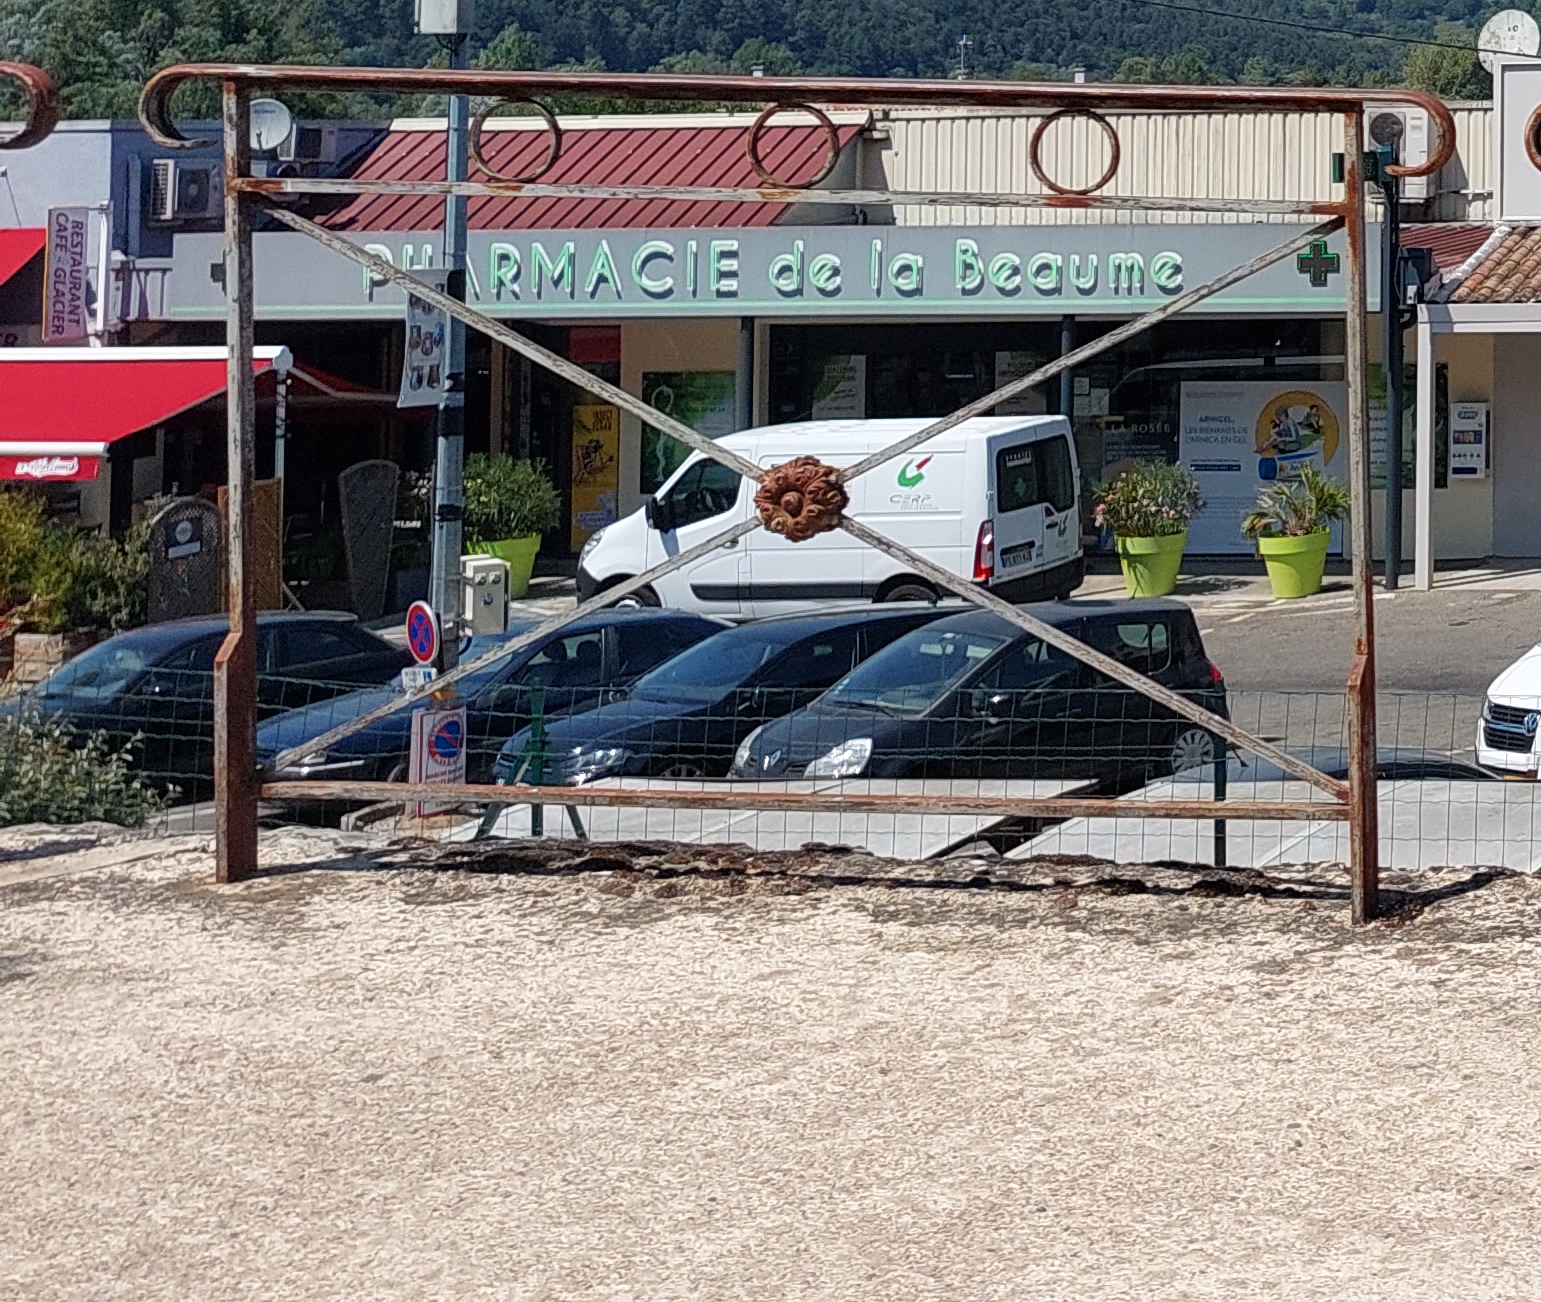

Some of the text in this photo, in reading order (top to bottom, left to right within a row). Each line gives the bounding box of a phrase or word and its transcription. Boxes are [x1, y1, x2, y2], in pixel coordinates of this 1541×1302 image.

[68, 219, 84, 327] RESTAURANT
[768, 239, 841, 291] de
[871, 239, 923, 291] la
[955, 239, 1183, 291] Beaume
[51, 266, 67, 336] GLACIER
[889, 493, 931, 504] CERP
